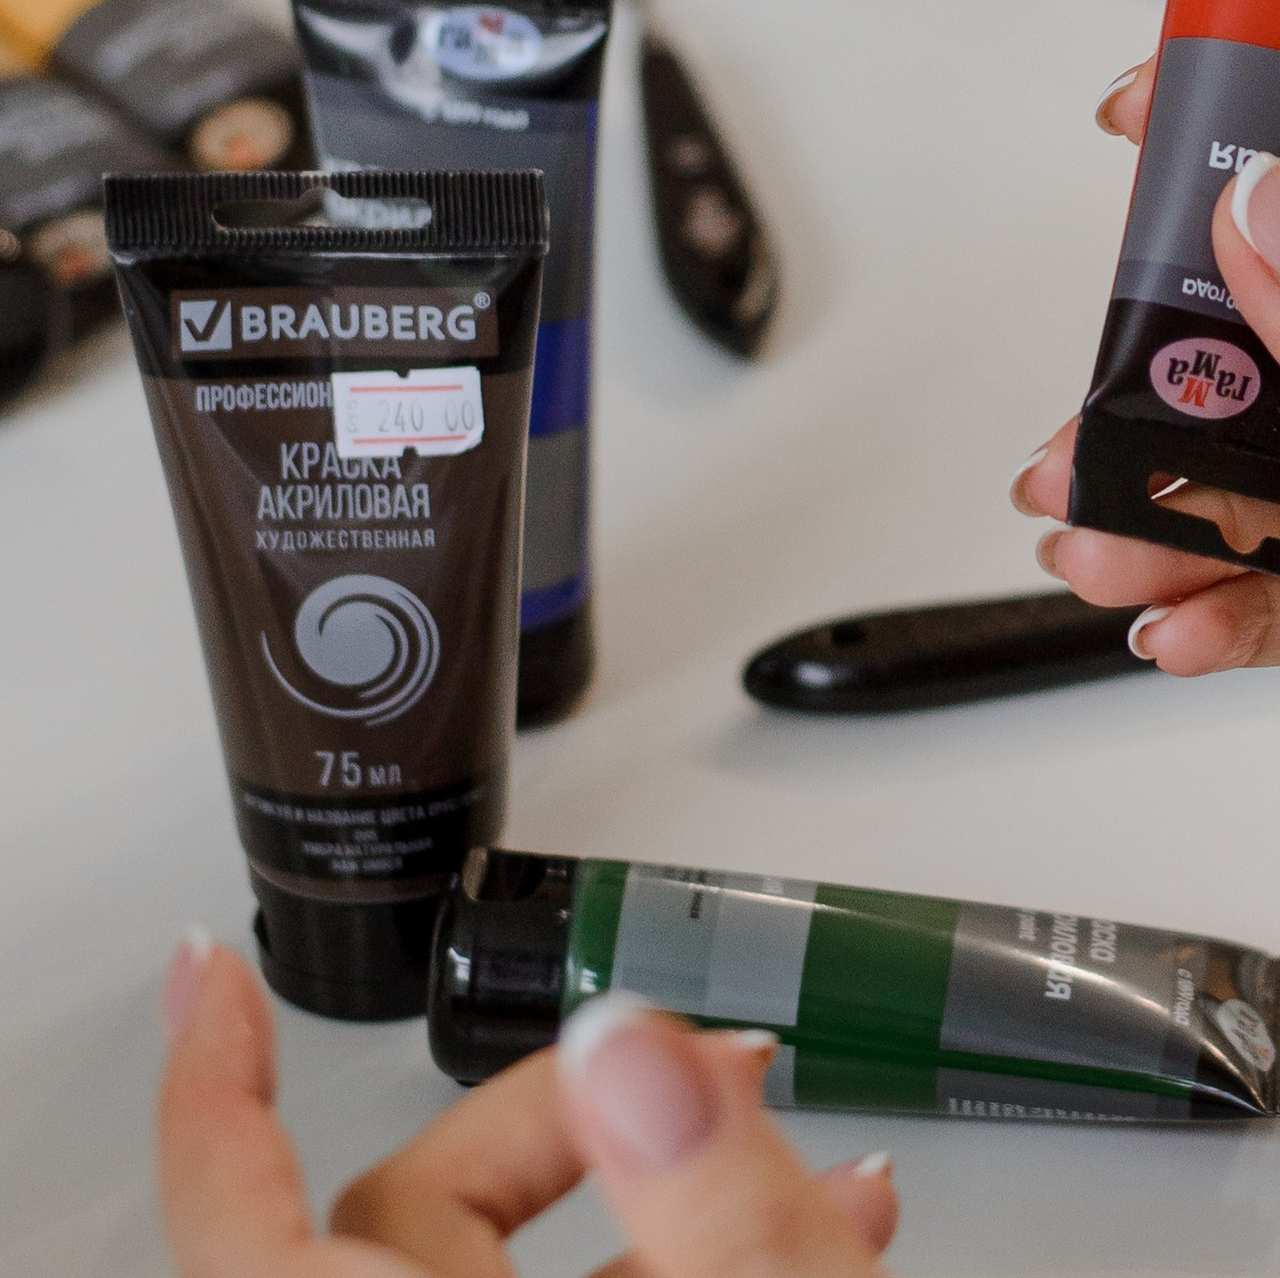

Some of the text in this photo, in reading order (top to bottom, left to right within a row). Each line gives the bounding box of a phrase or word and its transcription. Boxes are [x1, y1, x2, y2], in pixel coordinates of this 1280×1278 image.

[1181, 277, 1226, 303] года
[241, 303, 477, 343] BRAUBERG
[196, 381, 333, 413] ПРОФЕССИОН
[378, 400, 424, 433] 240
[257, 482, 431, 520] АКРИЛОВАЯ
[255, 527, 436, 552] ХУДОЖЕСТВЕННАЯ
[315, 750, 362, 789] 75
